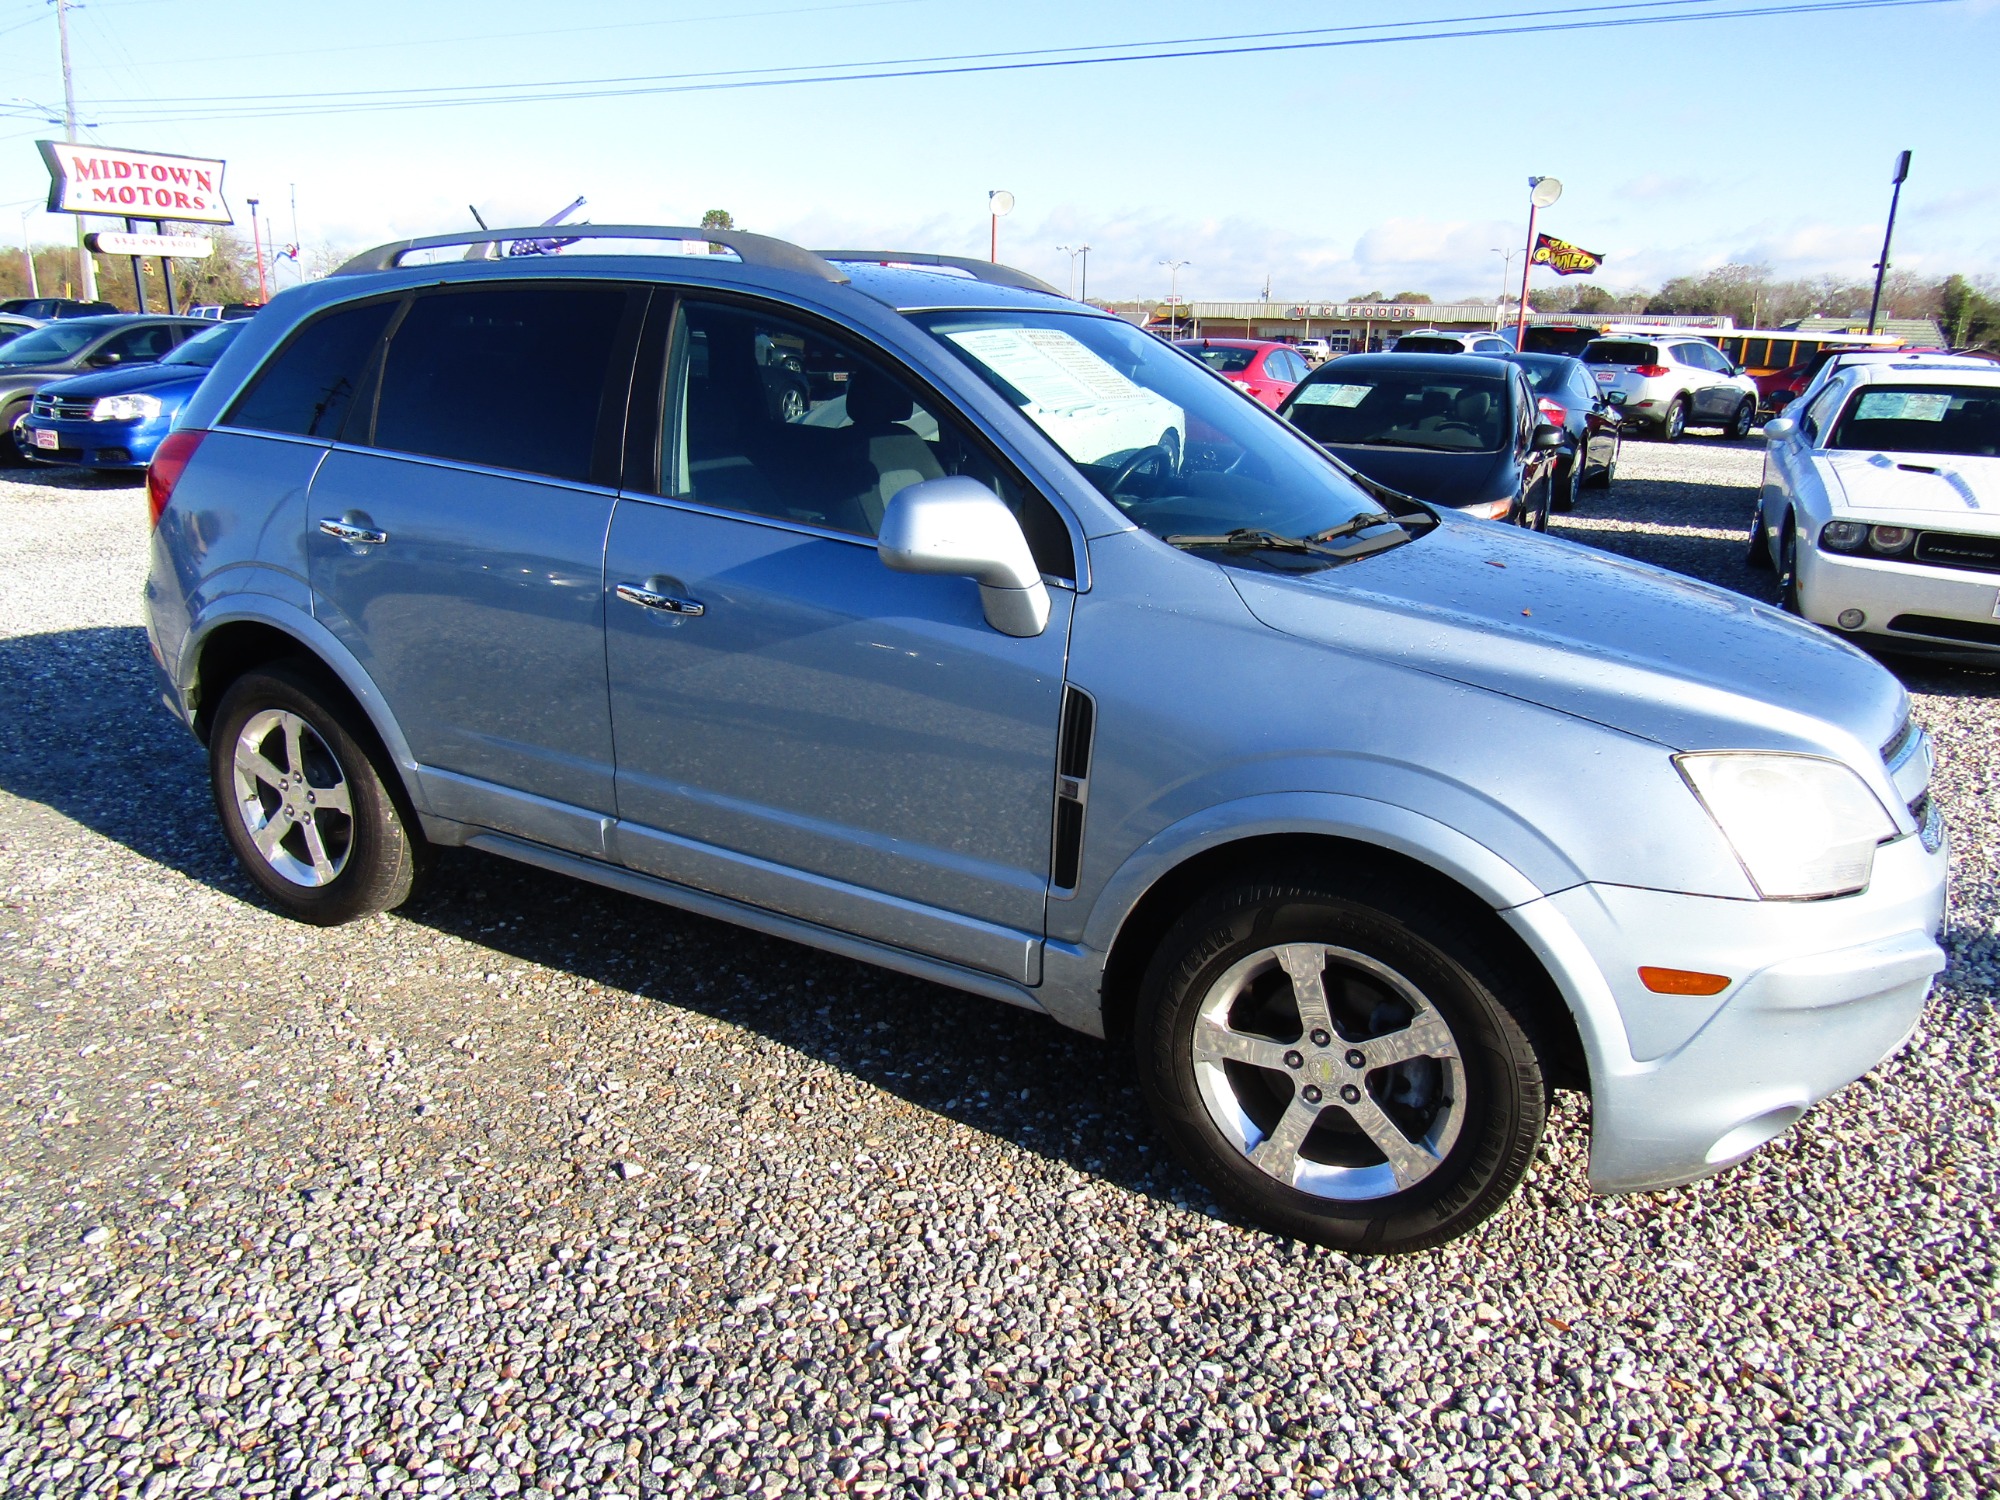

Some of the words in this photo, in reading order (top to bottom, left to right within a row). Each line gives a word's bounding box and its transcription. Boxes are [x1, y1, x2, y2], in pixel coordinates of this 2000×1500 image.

[72, 156, 212, 194] MIDTOWN
[92, 186, 206, 210] MOTORS
[1534, 247, 1596, 270] OWNED
[1351, 307, 1415, 318] FOODS
